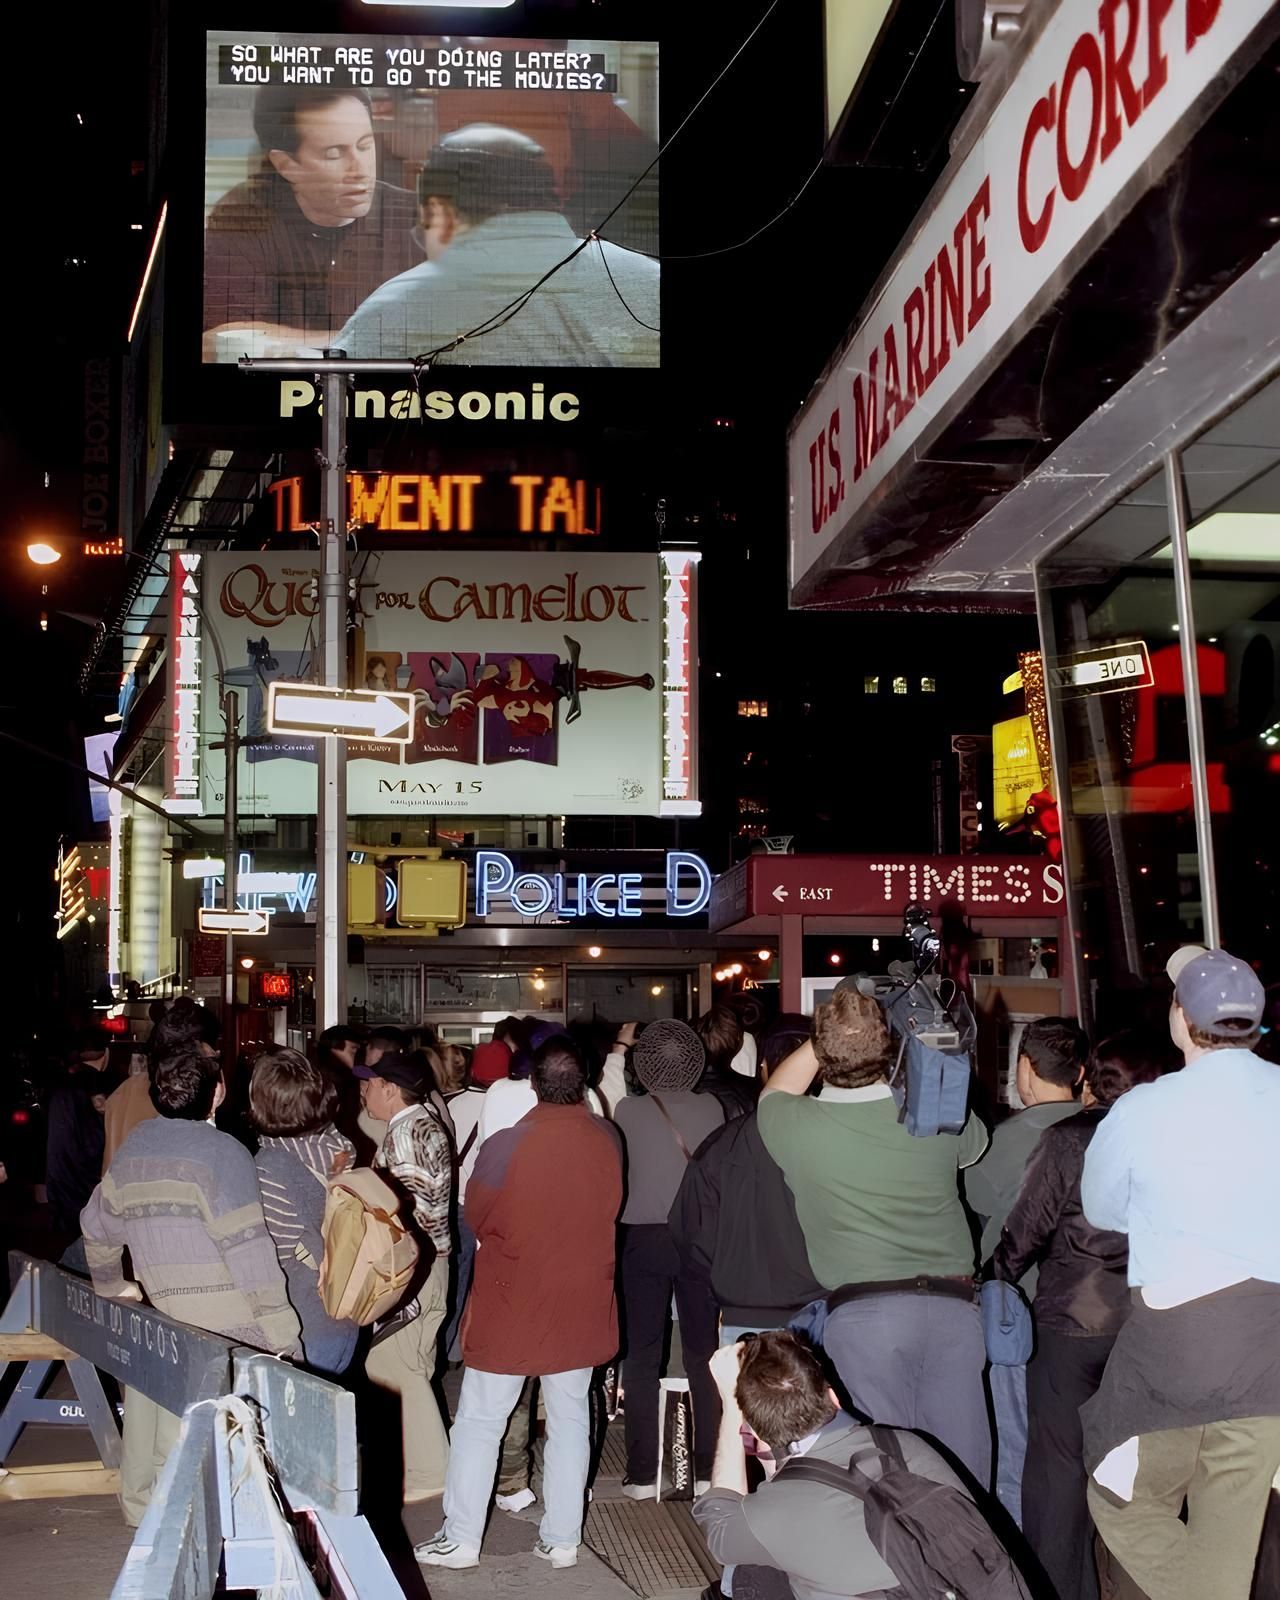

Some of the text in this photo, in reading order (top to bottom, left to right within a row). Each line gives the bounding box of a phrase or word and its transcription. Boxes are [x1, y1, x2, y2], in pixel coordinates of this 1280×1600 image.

[231, 45, 591, 70] SO WHAT ARE YOU DOING LATER?
[231, 65, 605, 90] YOU WANT TO GO TO THE MOVIES?
[809, 408, 845, 534] U.S.
[853, 174, 991, 484] MARINE
[280, 380, 580, 421] Pnasonic
[220, 563, 379, 628] Quet
[455, 780, 483, 794] 15
[475, 850, 643, 918] POLICE
[799, 887, 833, 901] EAST
[869, 864, 1032, 903] TIMES
